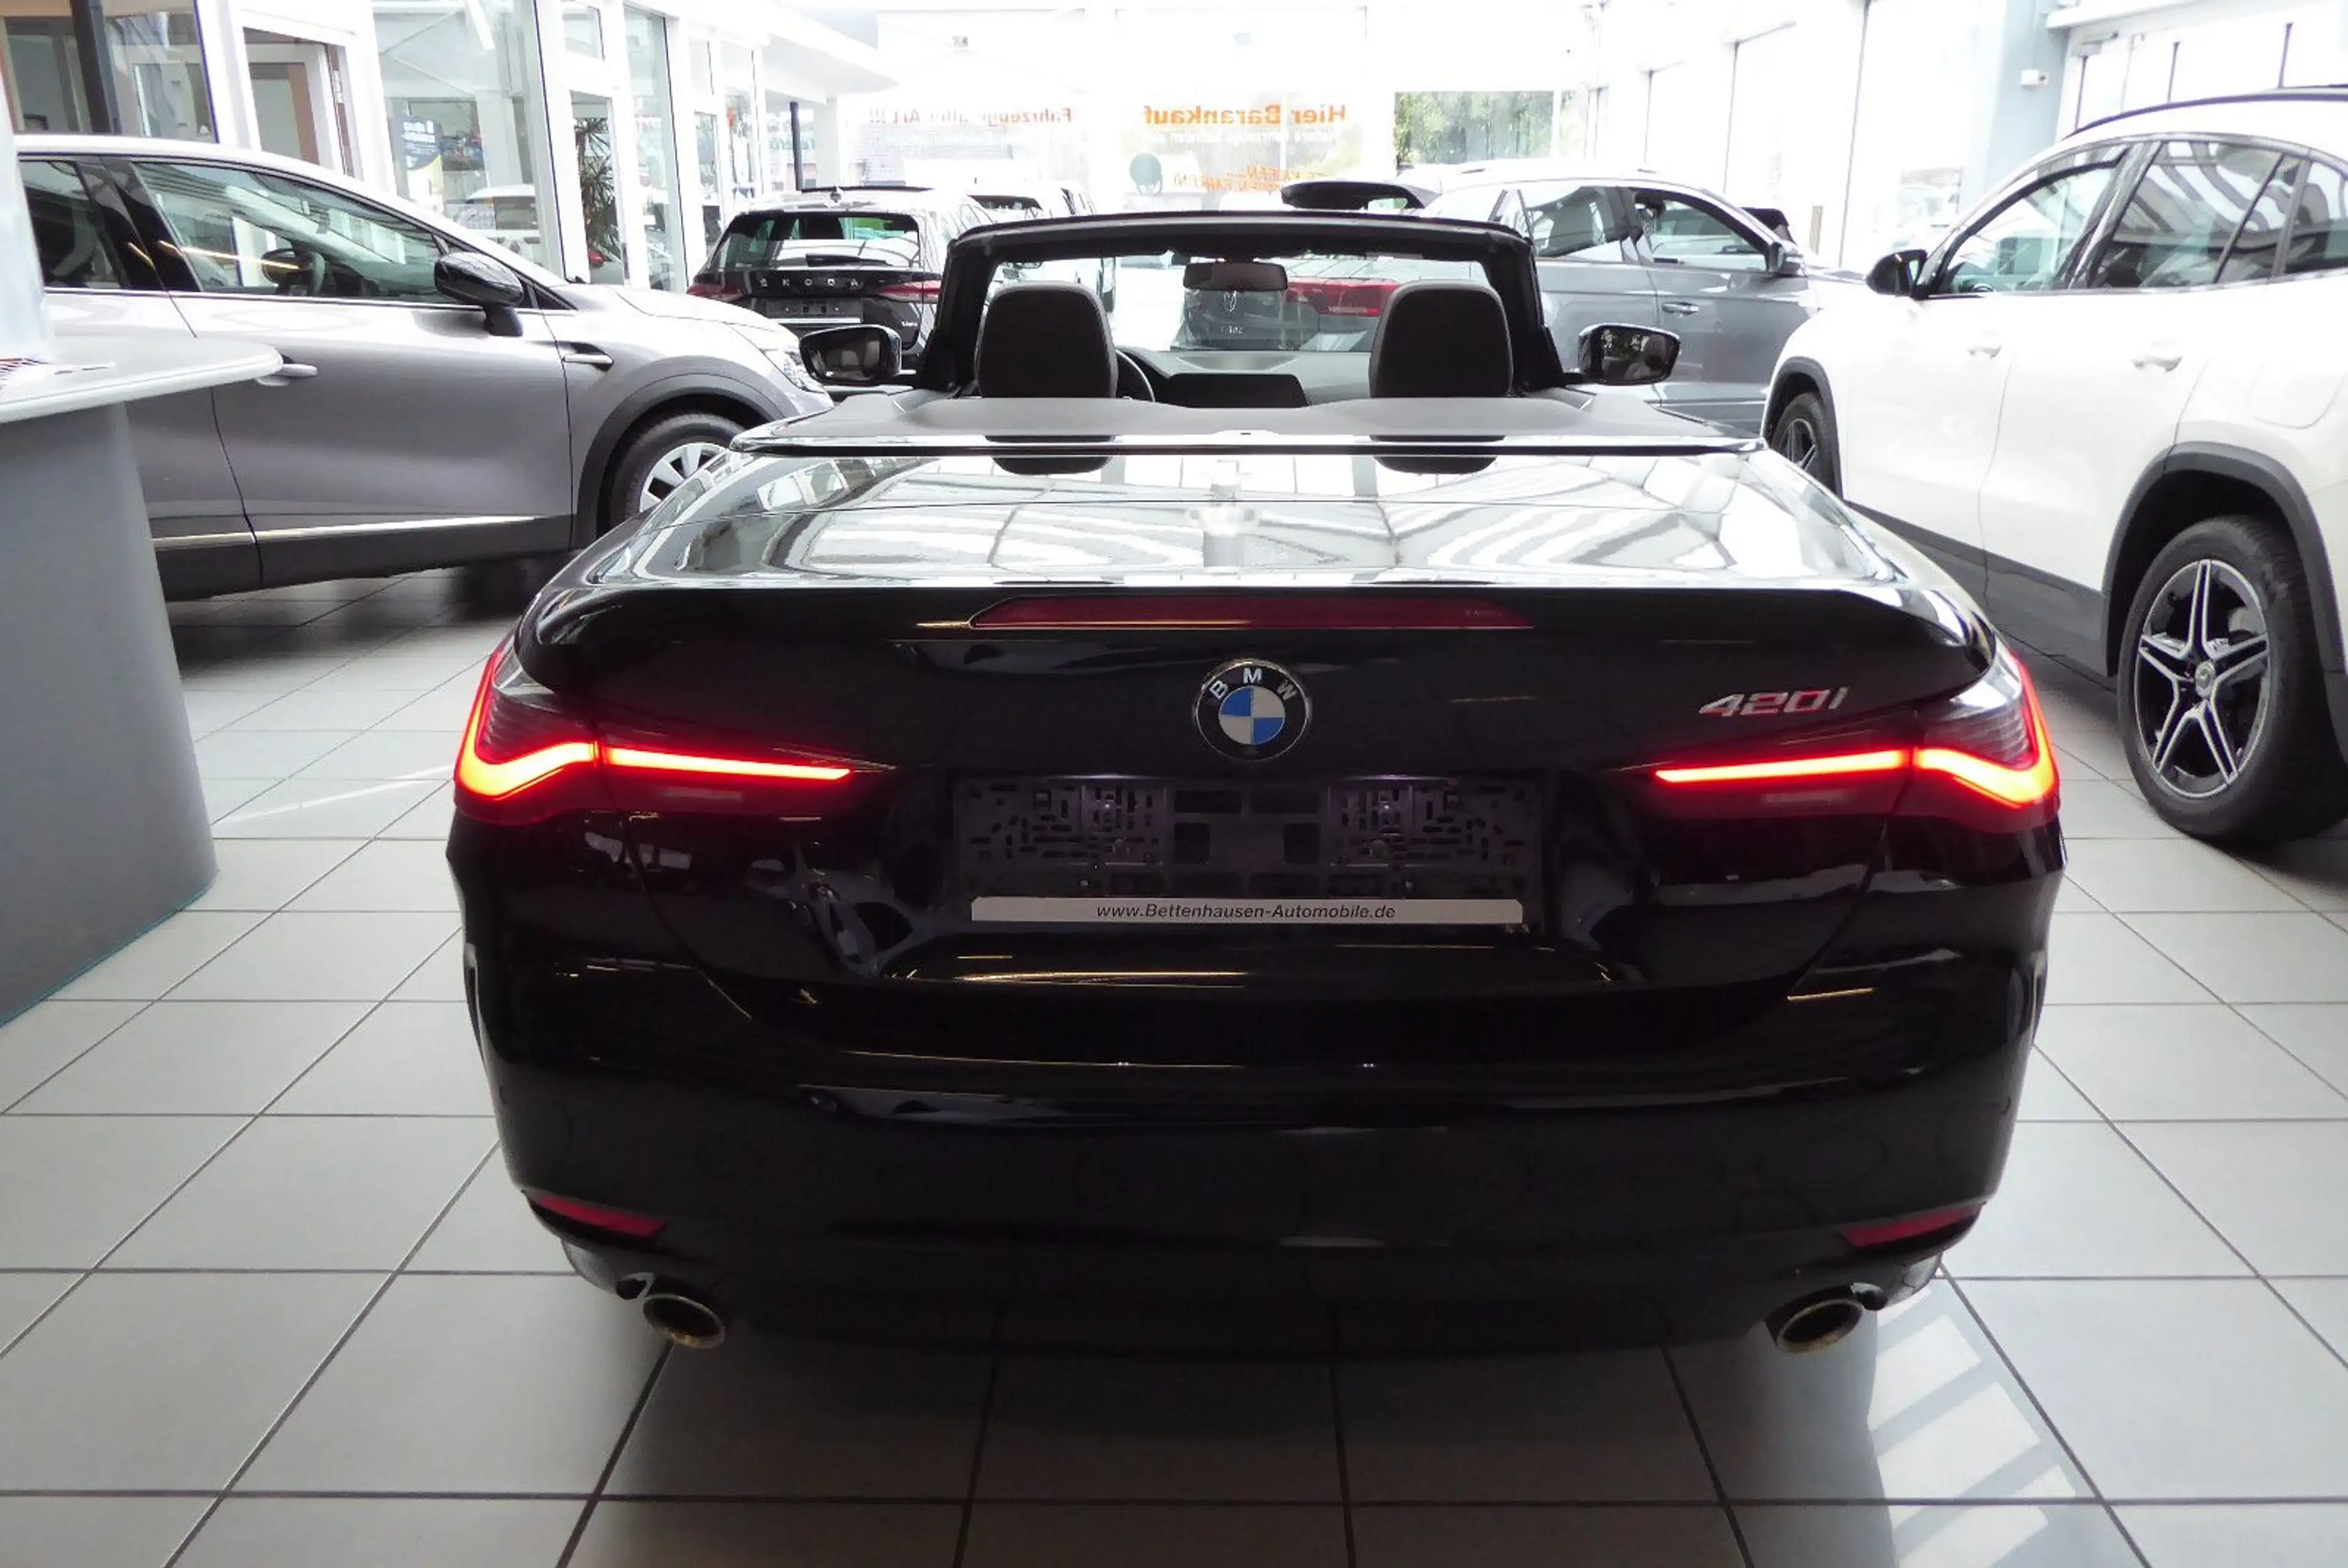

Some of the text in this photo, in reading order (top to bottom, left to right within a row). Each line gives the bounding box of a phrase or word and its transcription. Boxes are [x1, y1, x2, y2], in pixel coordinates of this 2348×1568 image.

[1208, 666, 1299, 701] BMW
[1697, 686, 1850, 717] 420i
[1096, 902, 1396, 919] www.Bettenhausen-Automobile.de
